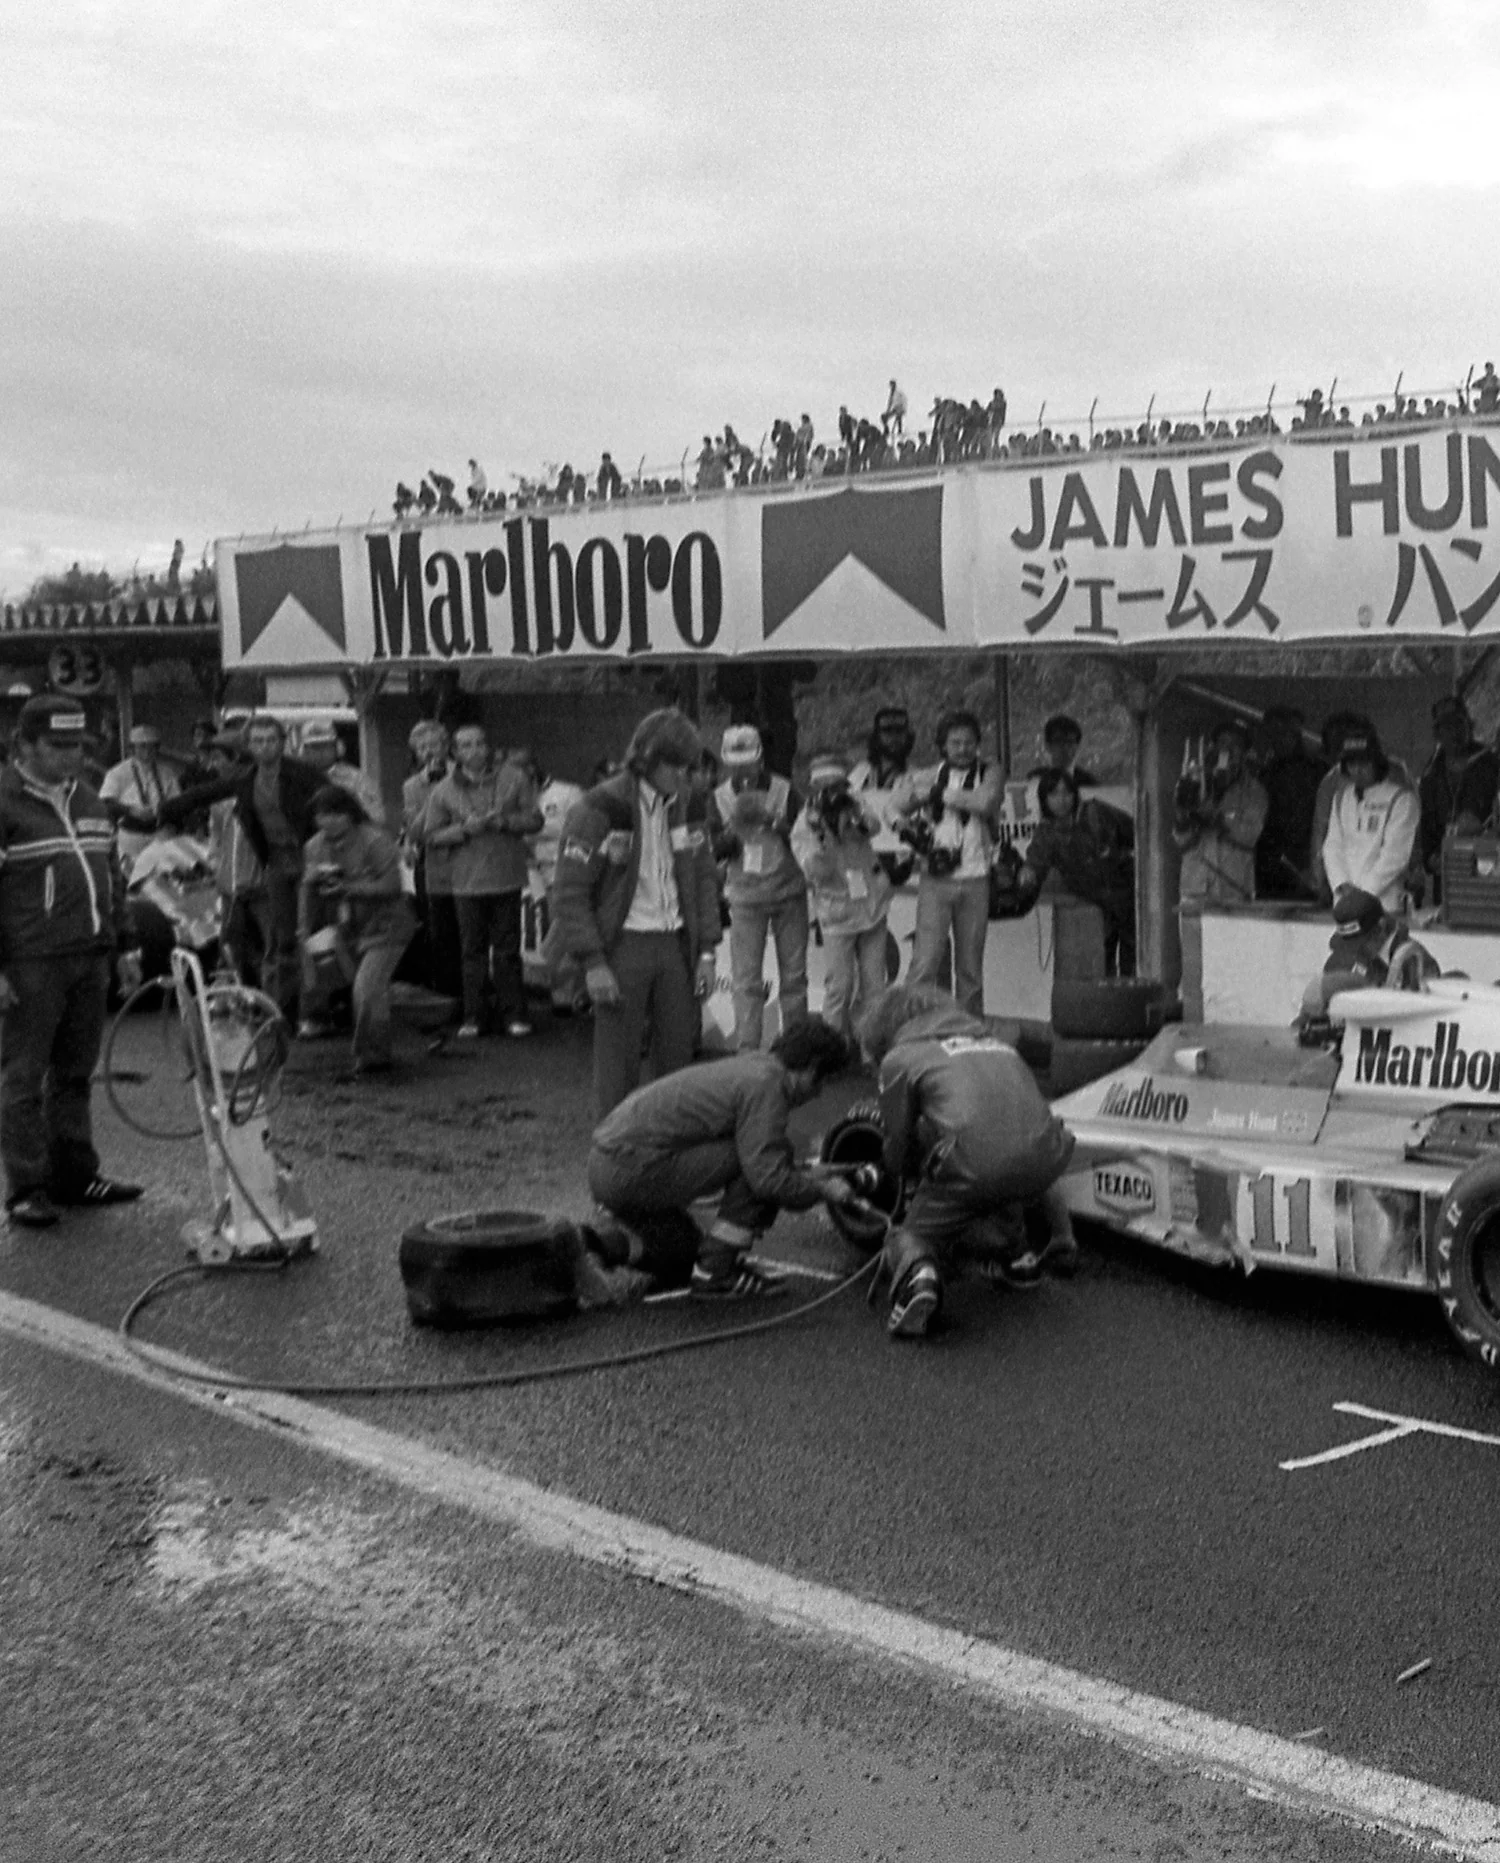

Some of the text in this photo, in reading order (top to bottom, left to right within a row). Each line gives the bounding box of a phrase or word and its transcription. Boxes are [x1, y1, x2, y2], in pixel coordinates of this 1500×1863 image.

[1010, 450, 1284, 551] JAMES
[365, 516, 723, 658] Marlboro
[1020, 548, 1281, 637] ジェームス
[58, 647, 102, 685] 33
[1098, 1076, 1189, 1122] Marlboro
[1096, 1171, 1152, 1201] TEXACO
[1248, 1175, 1317, 1257] 11
